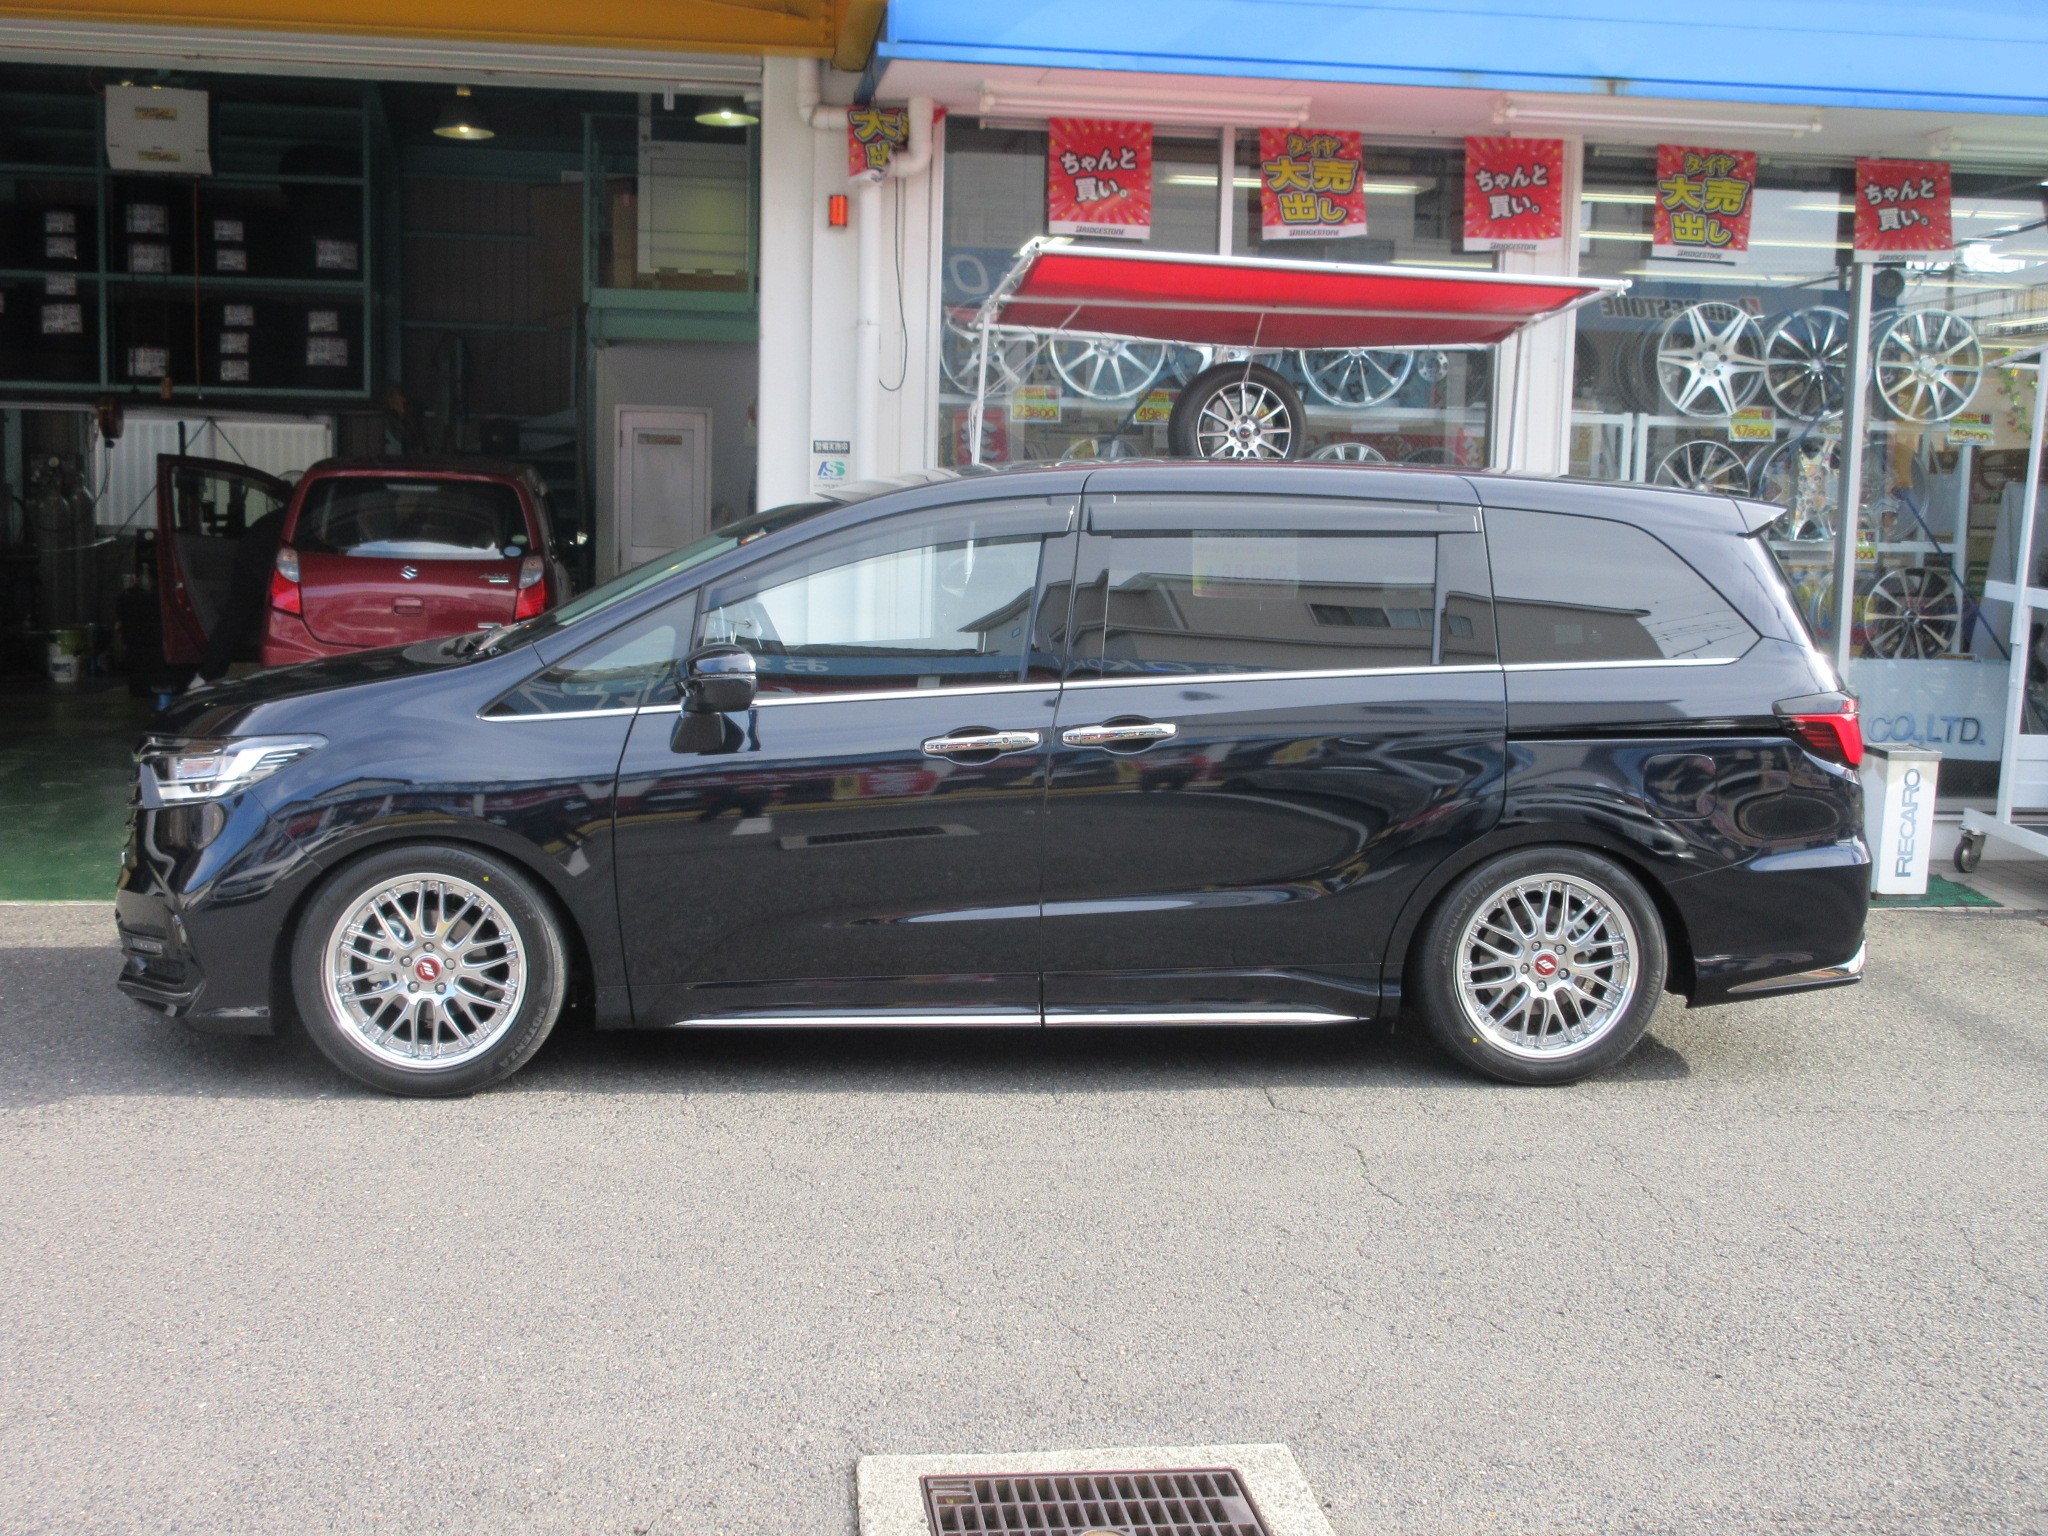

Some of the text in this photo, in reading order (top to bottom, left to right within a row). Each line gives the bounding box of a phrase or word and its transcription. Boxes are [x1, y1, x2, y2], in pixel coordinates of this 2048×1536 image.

[1286, 133, 1342, 158] タイヤ
[1060, 147, 1137, 175] ちゃんと
[1262, 155, 1359, 195] 大売
[1684, 152, 1736, 177] タイヤ
[1474, 164, 1549, 192] ちゃんと
[1863, 178, 1936, 206] ちゃんと
[1278, 190, 1347, 225] 出し
[1658, 174, 1750, 216] 大売
[1075, 225, 1126, 236] BRIDGESTONE
[1289, 228, 1340, 237] BRIDGESTONE
[1670, 210, 1733, 246] 出し
[1490, 242, 1538, 251] BRIDGESTONE
[1677, 249, 1723, 260] BRIDGESTONE
[1895, 768, 1921, 878] RECARO
